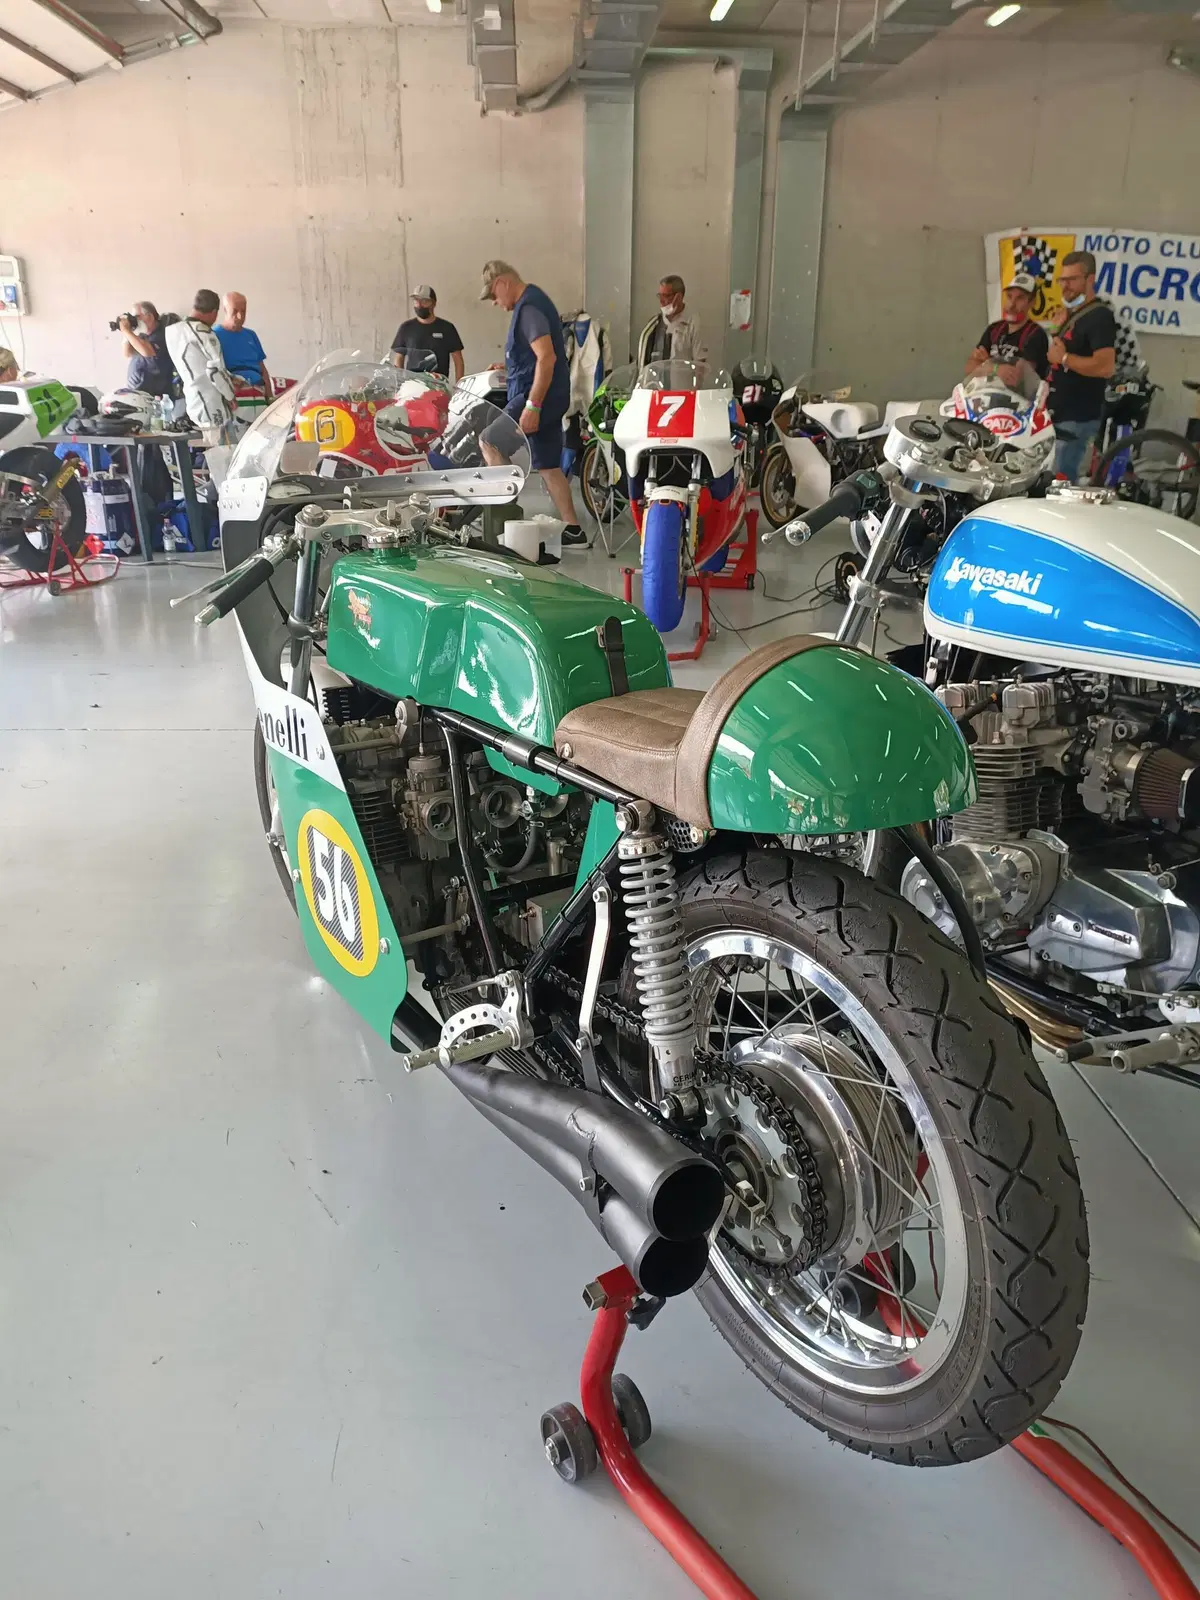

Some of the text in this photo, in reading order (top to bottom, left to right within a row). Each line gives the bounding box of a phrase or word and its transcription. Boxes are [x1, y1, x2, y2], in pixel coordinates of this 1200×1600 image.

[1083, 234, 1151, 255] MOTO
[1119, 304, 1181, 327] OGNA
[315, 408, 336, 444] 6
[657, 395, 686, 428] 7
[982, 417, 1014, 431] PATA
[944, 556, 1044, 596] Kawasaki
[312, 827, 356, 943] 56
